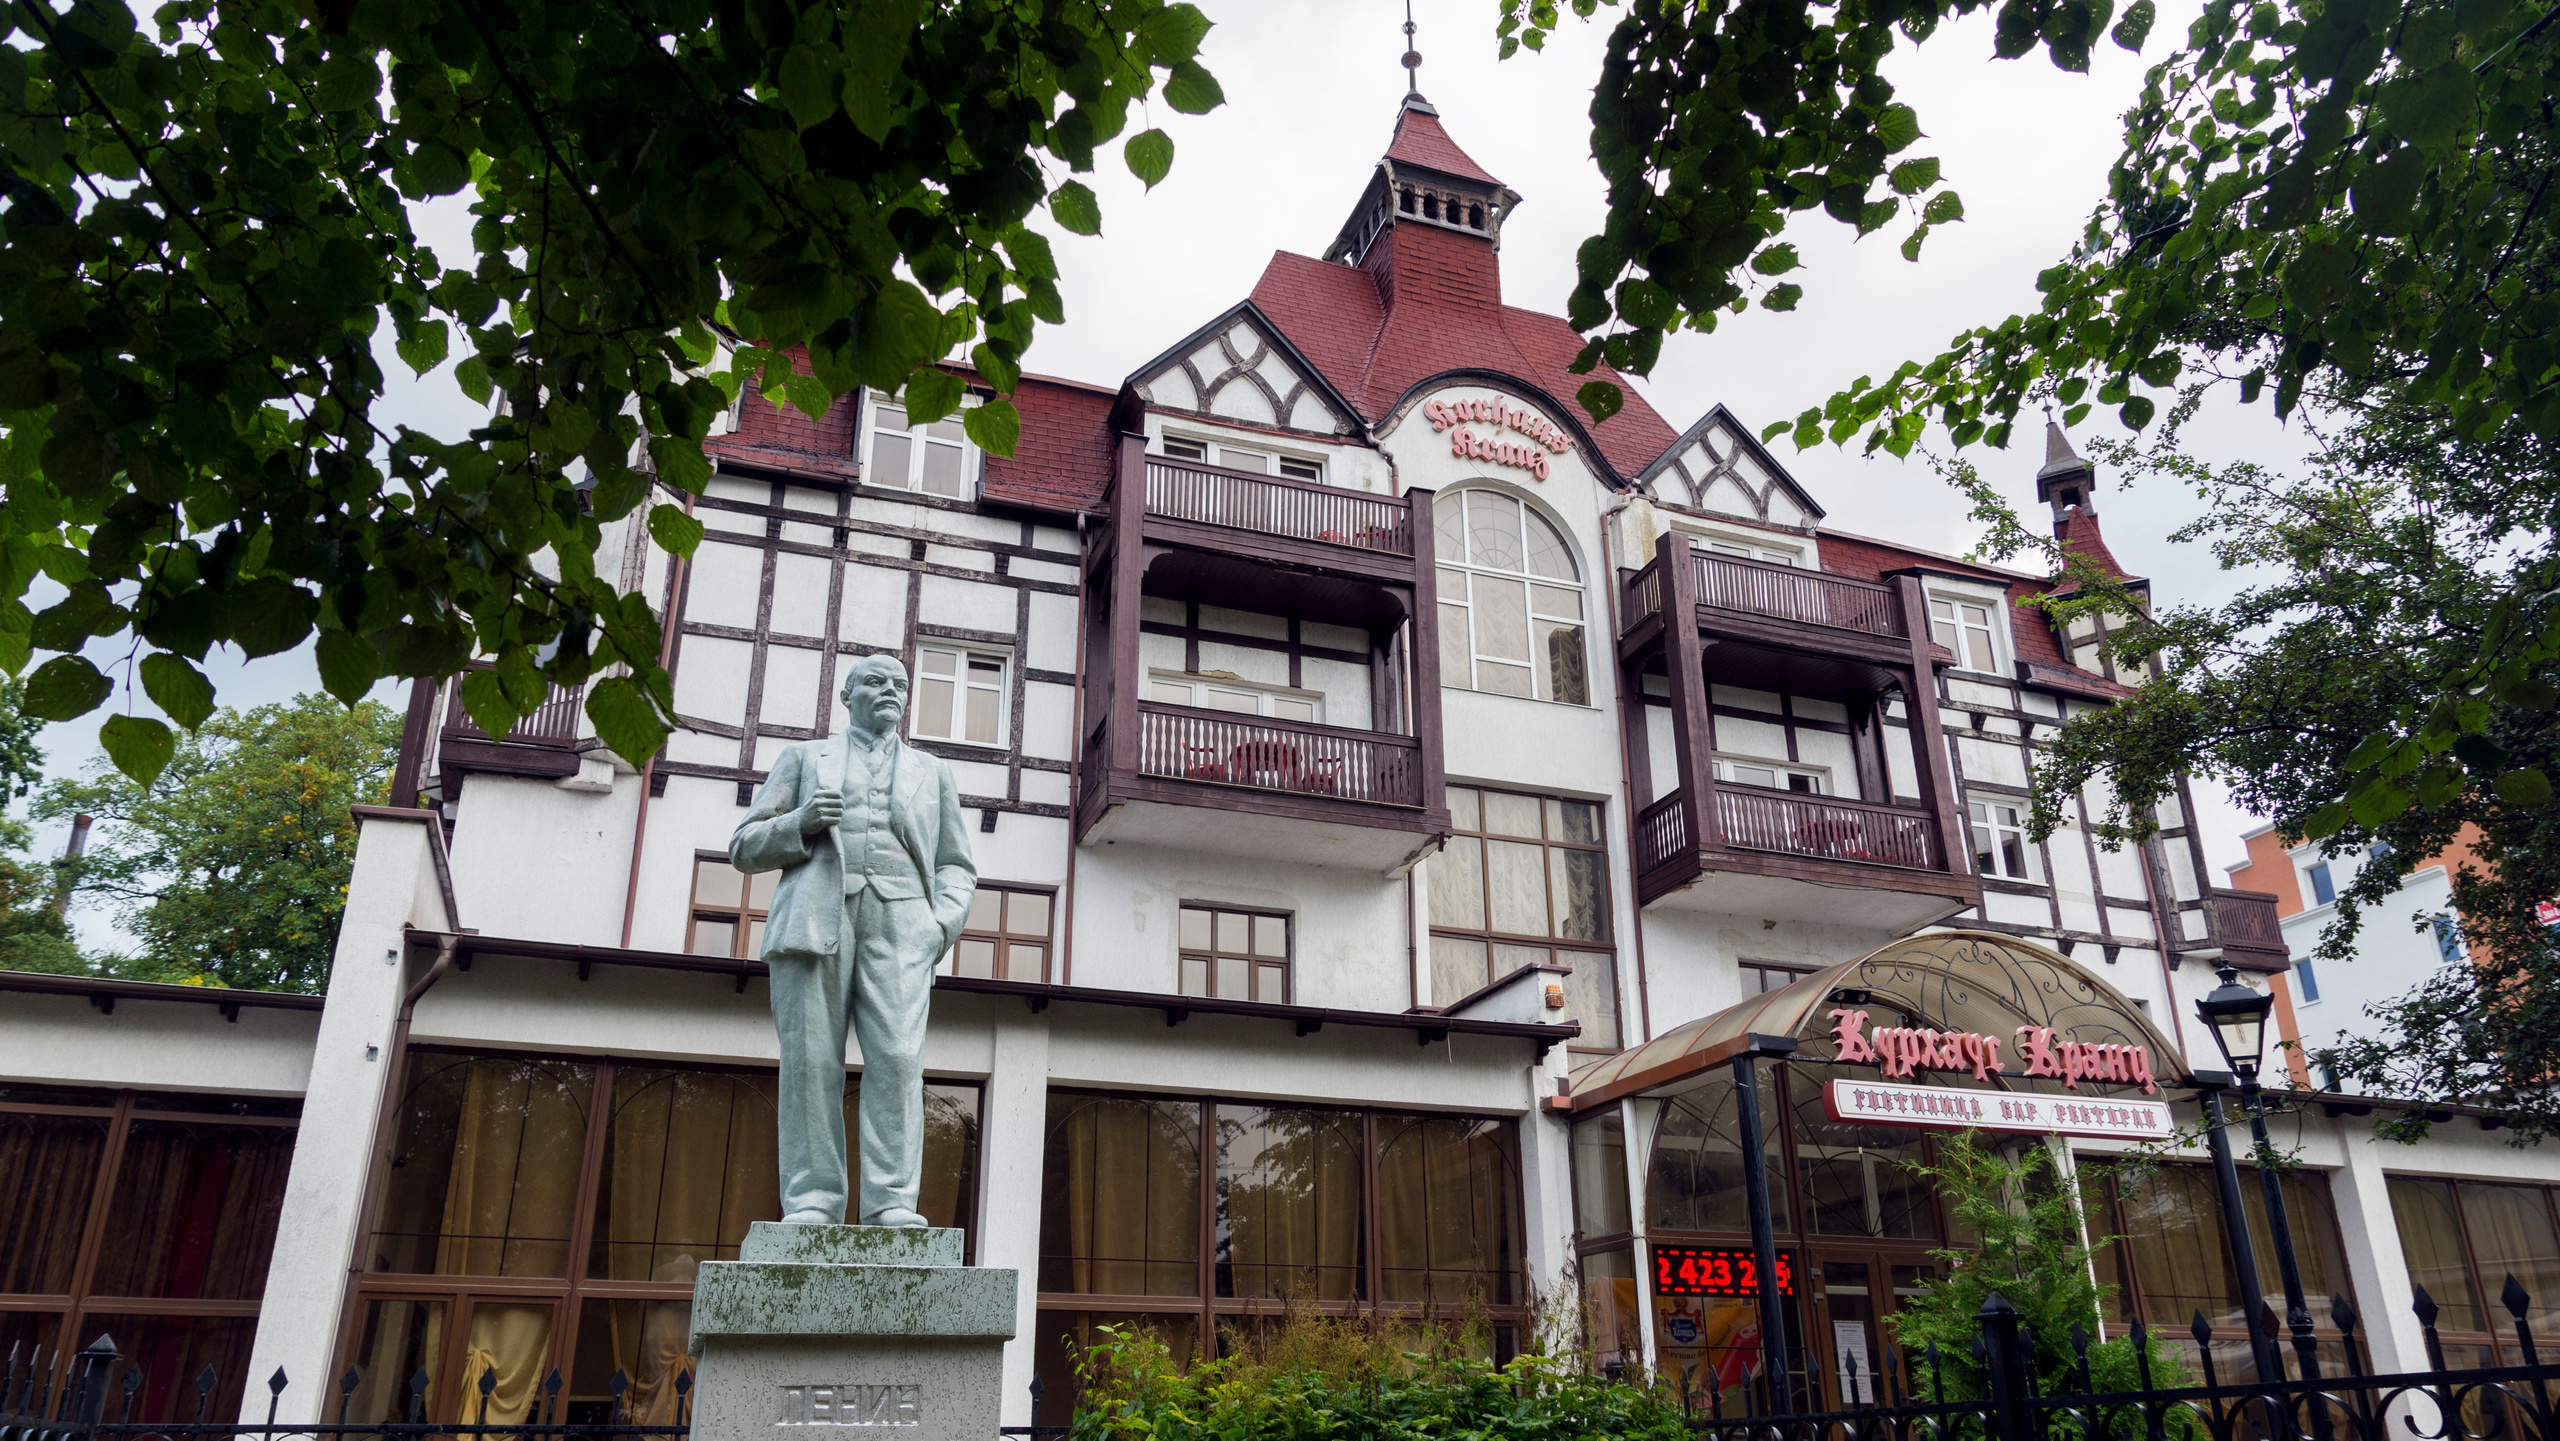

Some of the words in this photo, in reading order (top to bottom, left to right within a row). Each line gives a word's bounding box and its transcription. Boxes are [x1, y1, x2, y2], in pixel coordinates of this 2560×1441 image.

[1451, 425, 1549, 482] Kranz
[1826, 1008, 2005, 1082] Курхаус
[2016, 1025, 2156, 1095] Кранц
[1853, 1088, 1983, 1121] ГОСТИНИЦА
[1999, 1099, 2038, 1122] БАР
[2054, 1103, 2157, 1129] РЕСТОРАН
[1679, 1258, 1732, 1286] 423
[1739, 1260, 1788, 1288] 25
